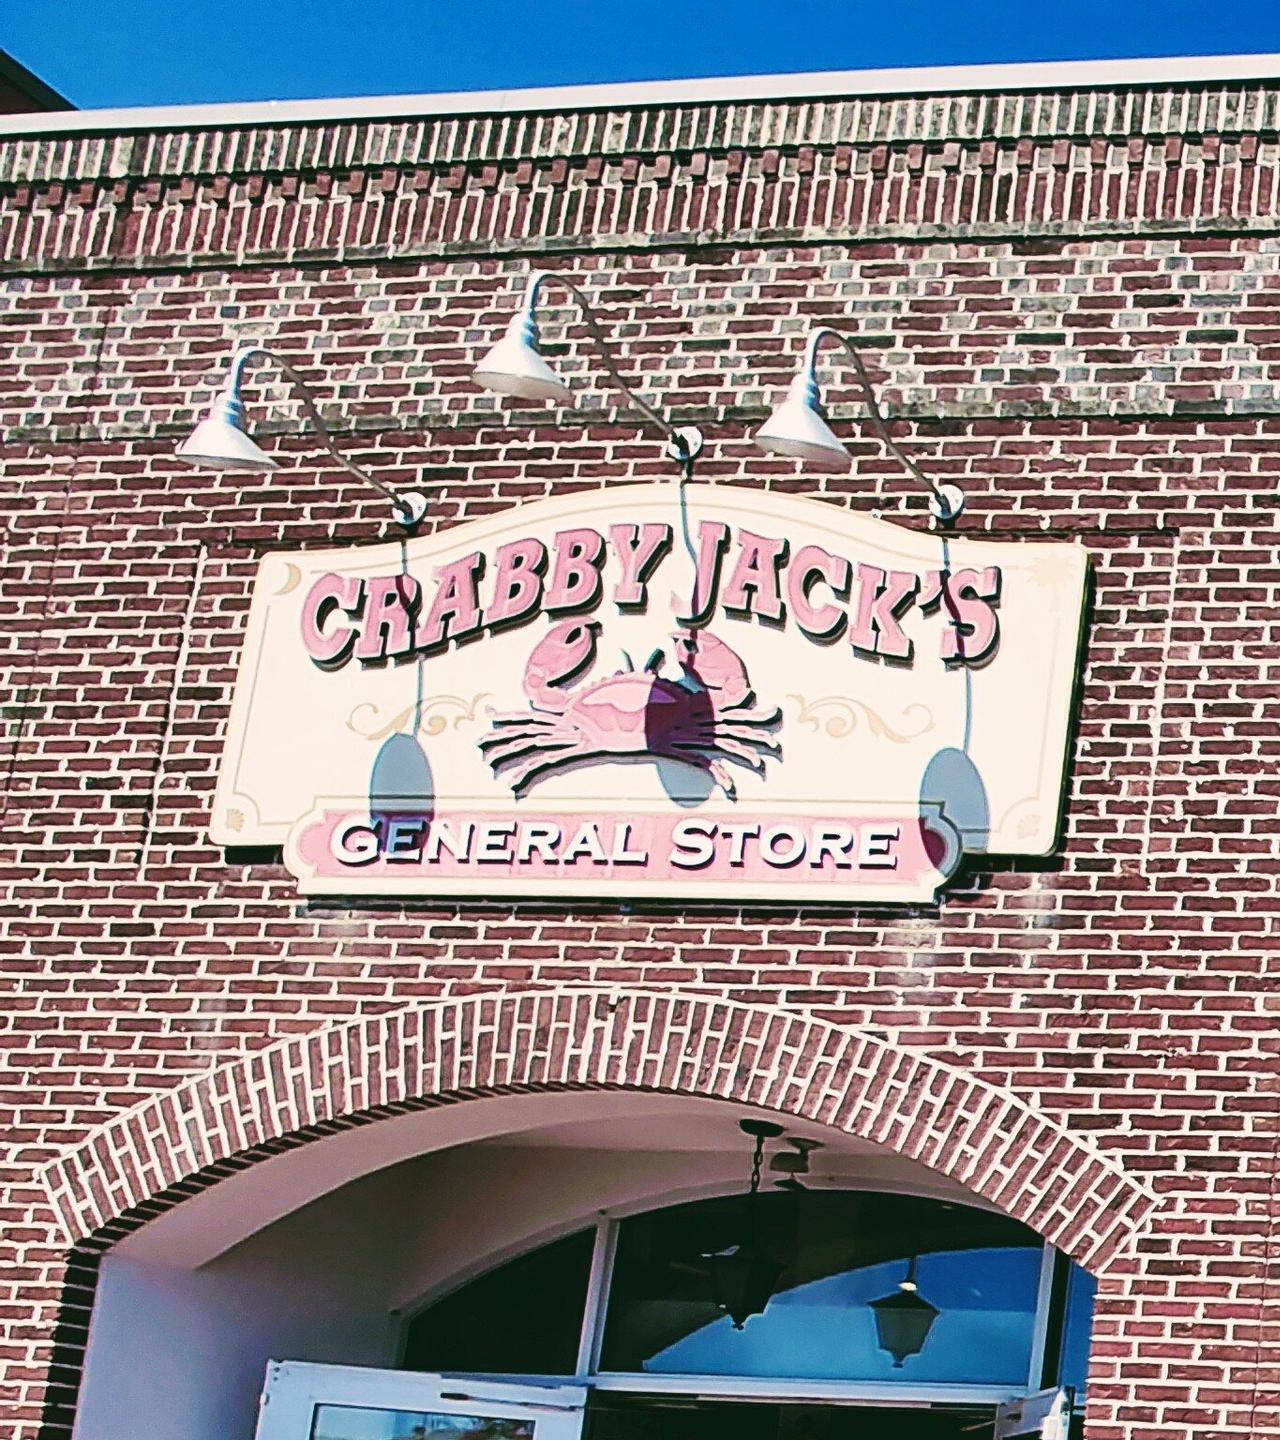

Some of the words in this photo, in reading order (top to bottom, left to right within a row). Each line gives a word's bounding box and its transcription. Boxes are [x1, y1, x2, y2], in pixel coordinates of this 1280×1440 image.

[301, 522, 671, 671] CRABBY
[672, 520, 1002, 671] JACK'S
[331, 816, 649, 869] GENERAL
[667, 820, 900, 872] STORE
